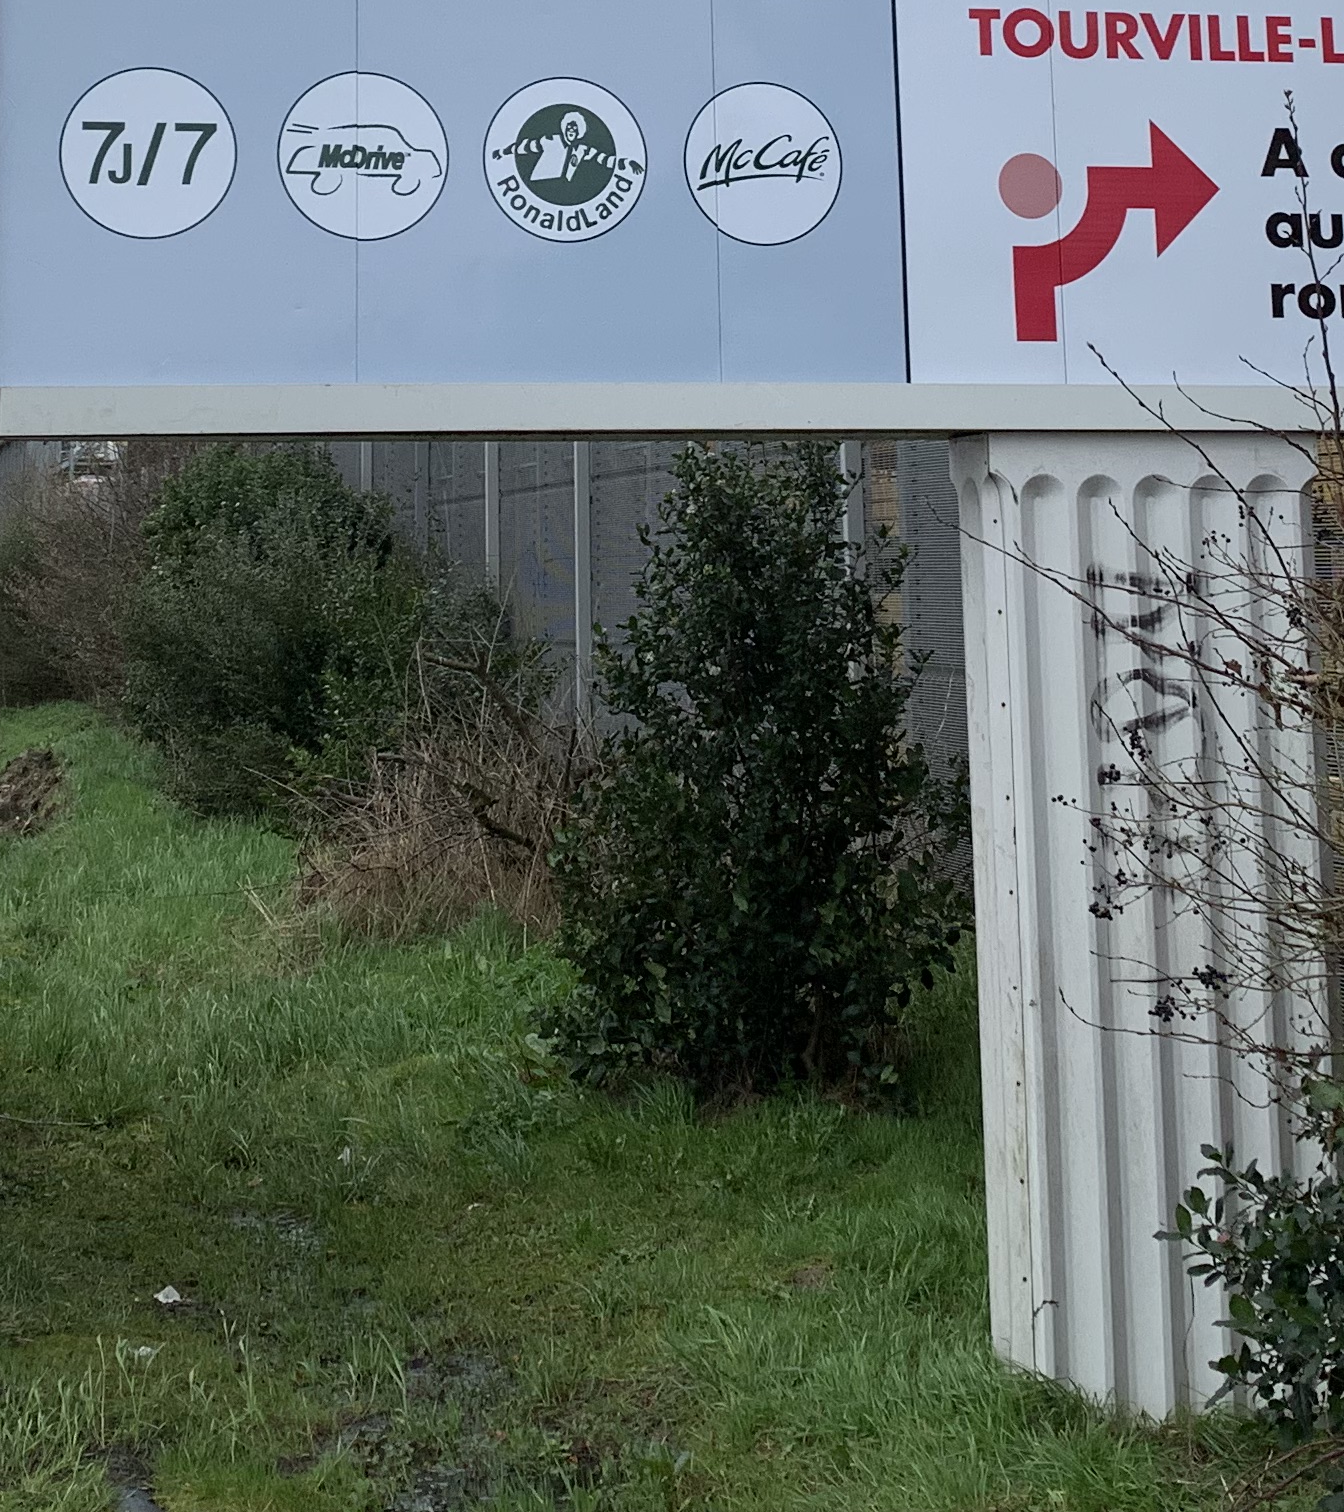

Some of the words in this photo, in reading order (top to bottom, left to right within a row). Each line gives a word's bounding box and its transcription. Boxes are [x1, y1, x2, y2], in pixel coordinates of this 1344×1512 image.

[318, 144, 405, 170] McDrive
[700, 134, 830, 188] McCafé
[1260, 128, 1310, 178] A
[497, 174, 634, 232] RonaldLand
[1265, 210, 1344, 251] au
